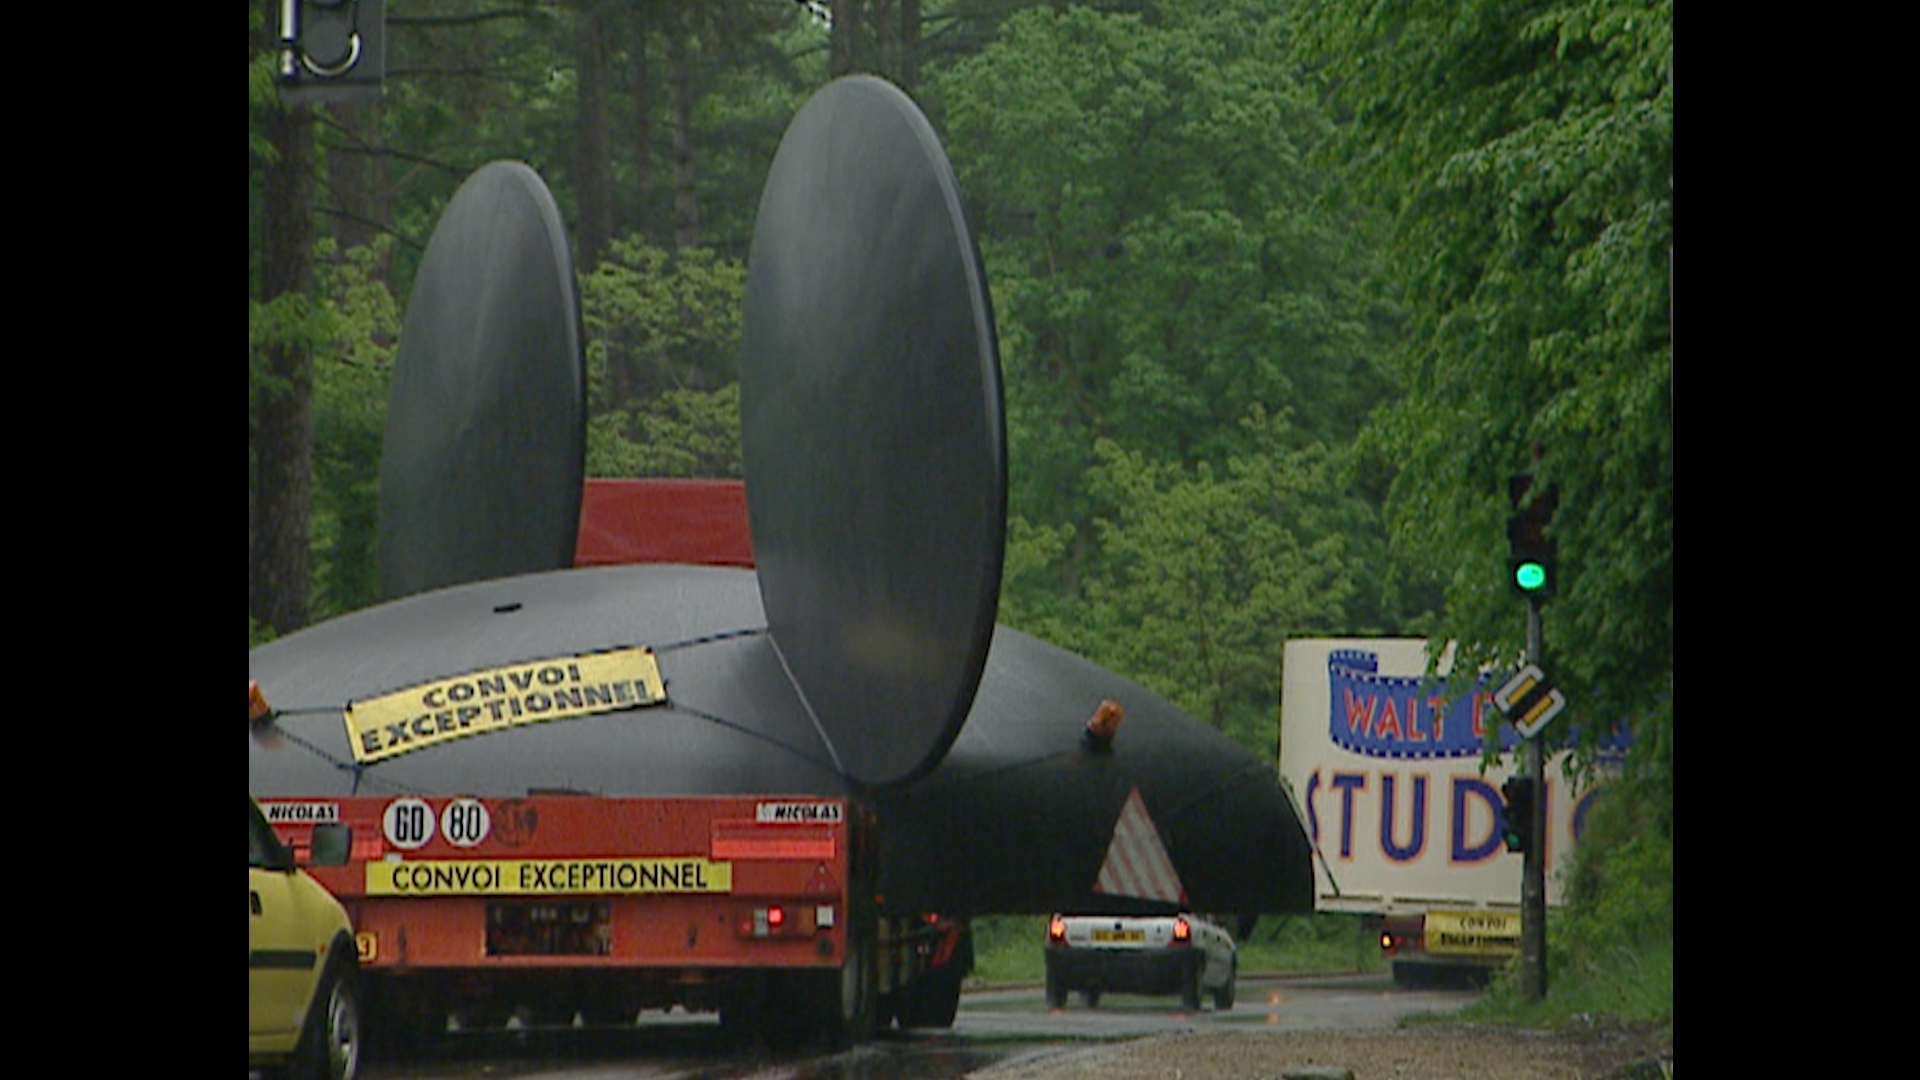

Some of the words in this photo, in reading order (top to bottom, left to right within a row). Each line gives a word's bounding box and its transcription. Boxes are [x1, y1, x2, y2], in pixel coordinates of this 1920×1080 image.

[423, 663, 581, 709] CONVOI
[360, 680, 654, 755] EXCEPTIONNEL
[1343, 688, 1449, 741] WALT
[269, 805, 334, 819] NICOLAS
[451, 803, 480, 841] 80
[775, 805, 838, 819] NICOLAS
[392, 864, 500, 890] CONVOI
[519, 862, 707, 889] EXCEPTIONNEL
